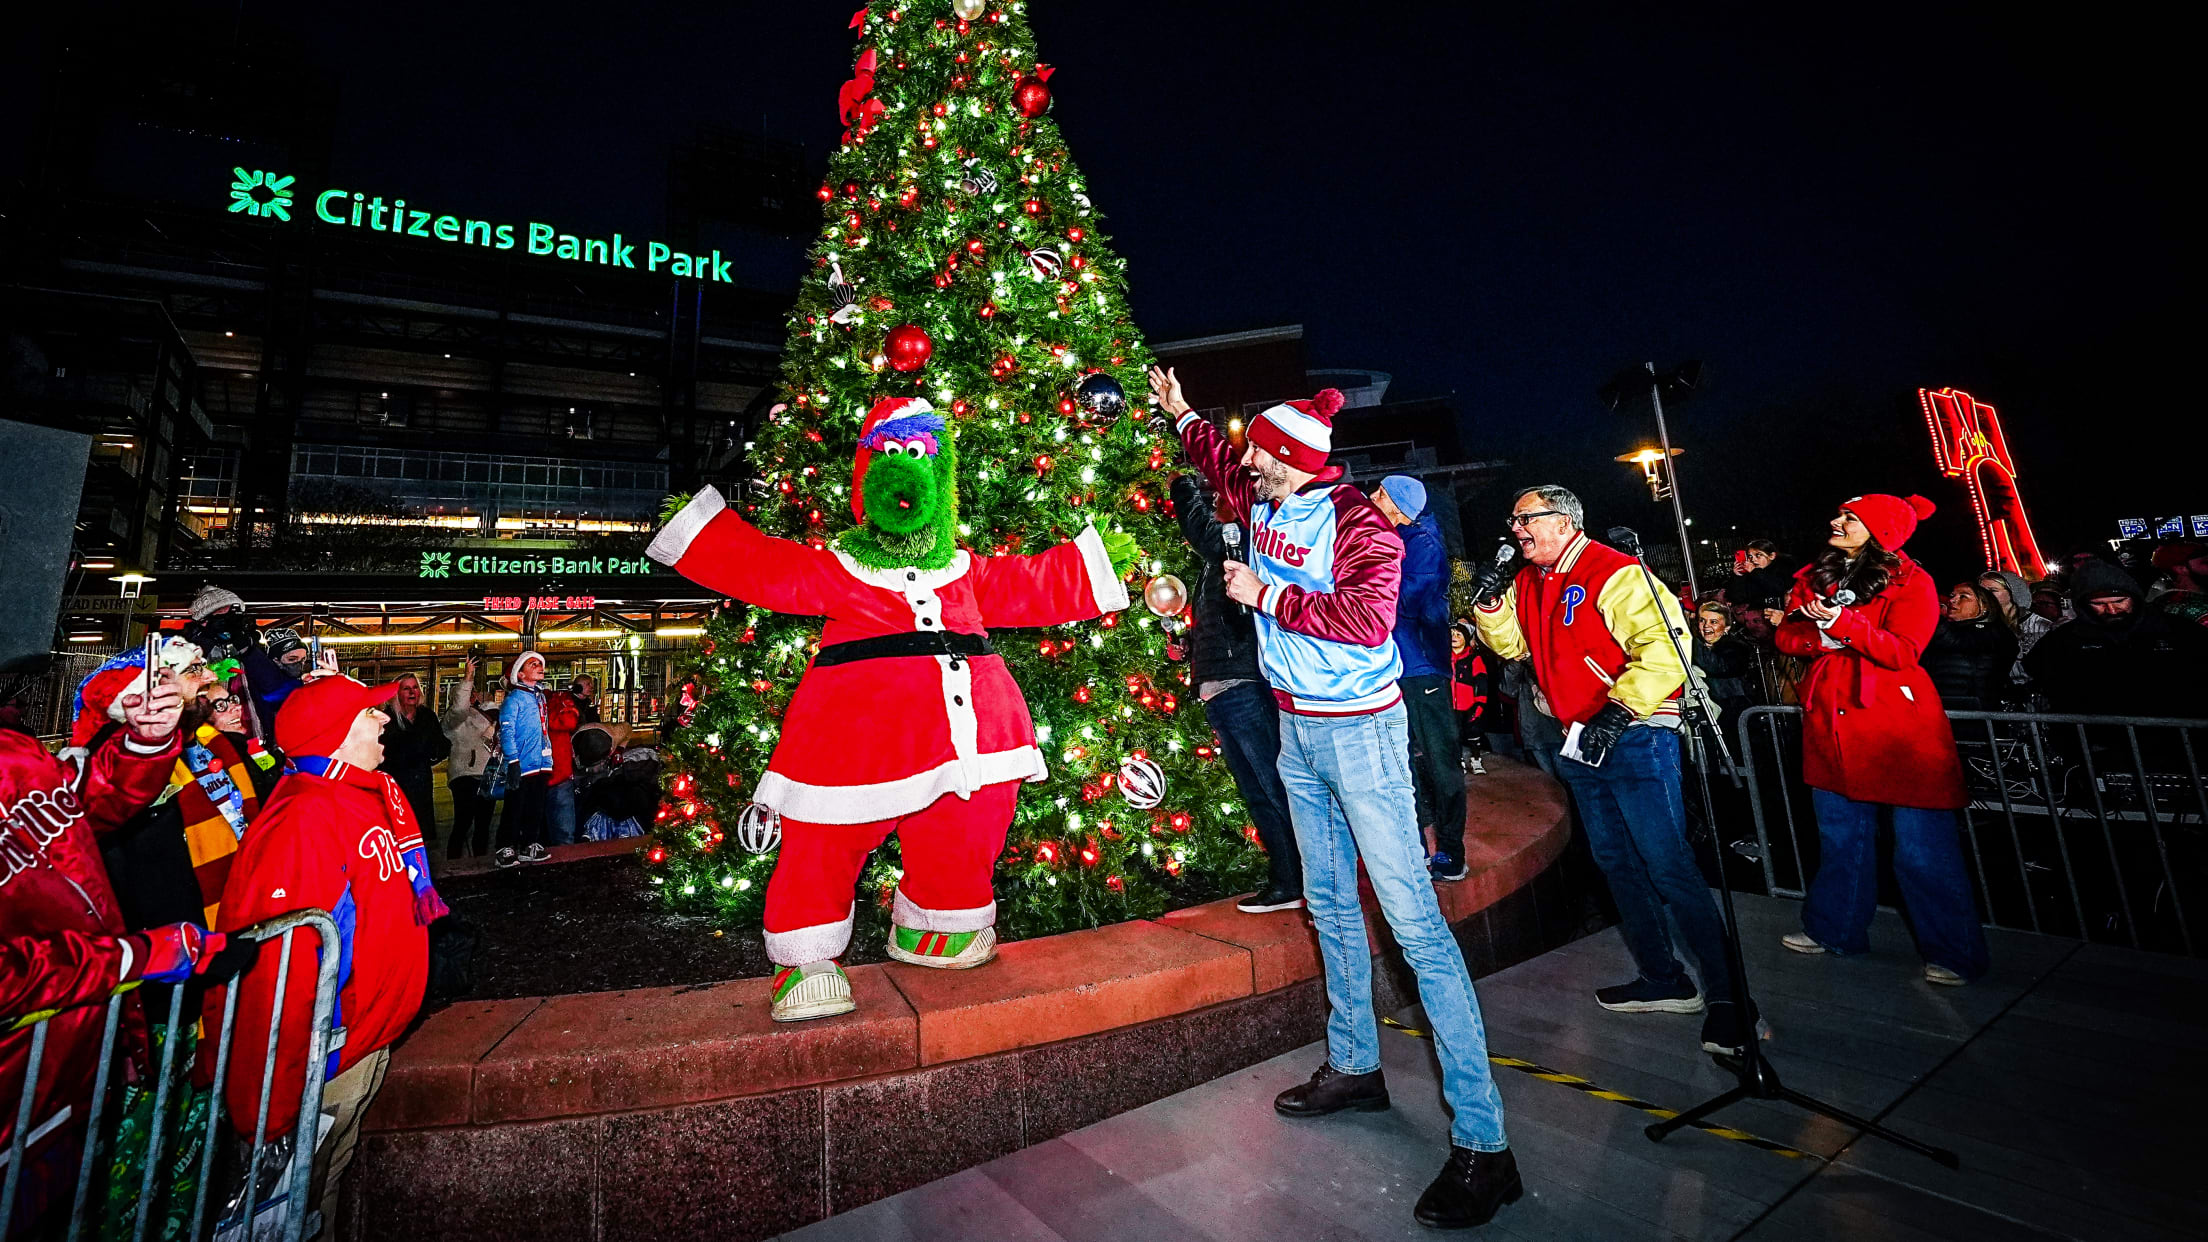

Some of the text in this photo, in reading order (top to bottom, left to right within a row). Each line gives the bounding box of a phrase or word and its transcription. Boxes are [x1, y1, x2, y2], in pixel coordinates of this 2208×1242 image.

[315, 189, 733, 283] Citizens Bank Park
[458, 555, 650, 575] Citizens Bank Park
[483, 596, 596, 611] THIRD BASE GATE
[1561, 584, 1586, 626] P
